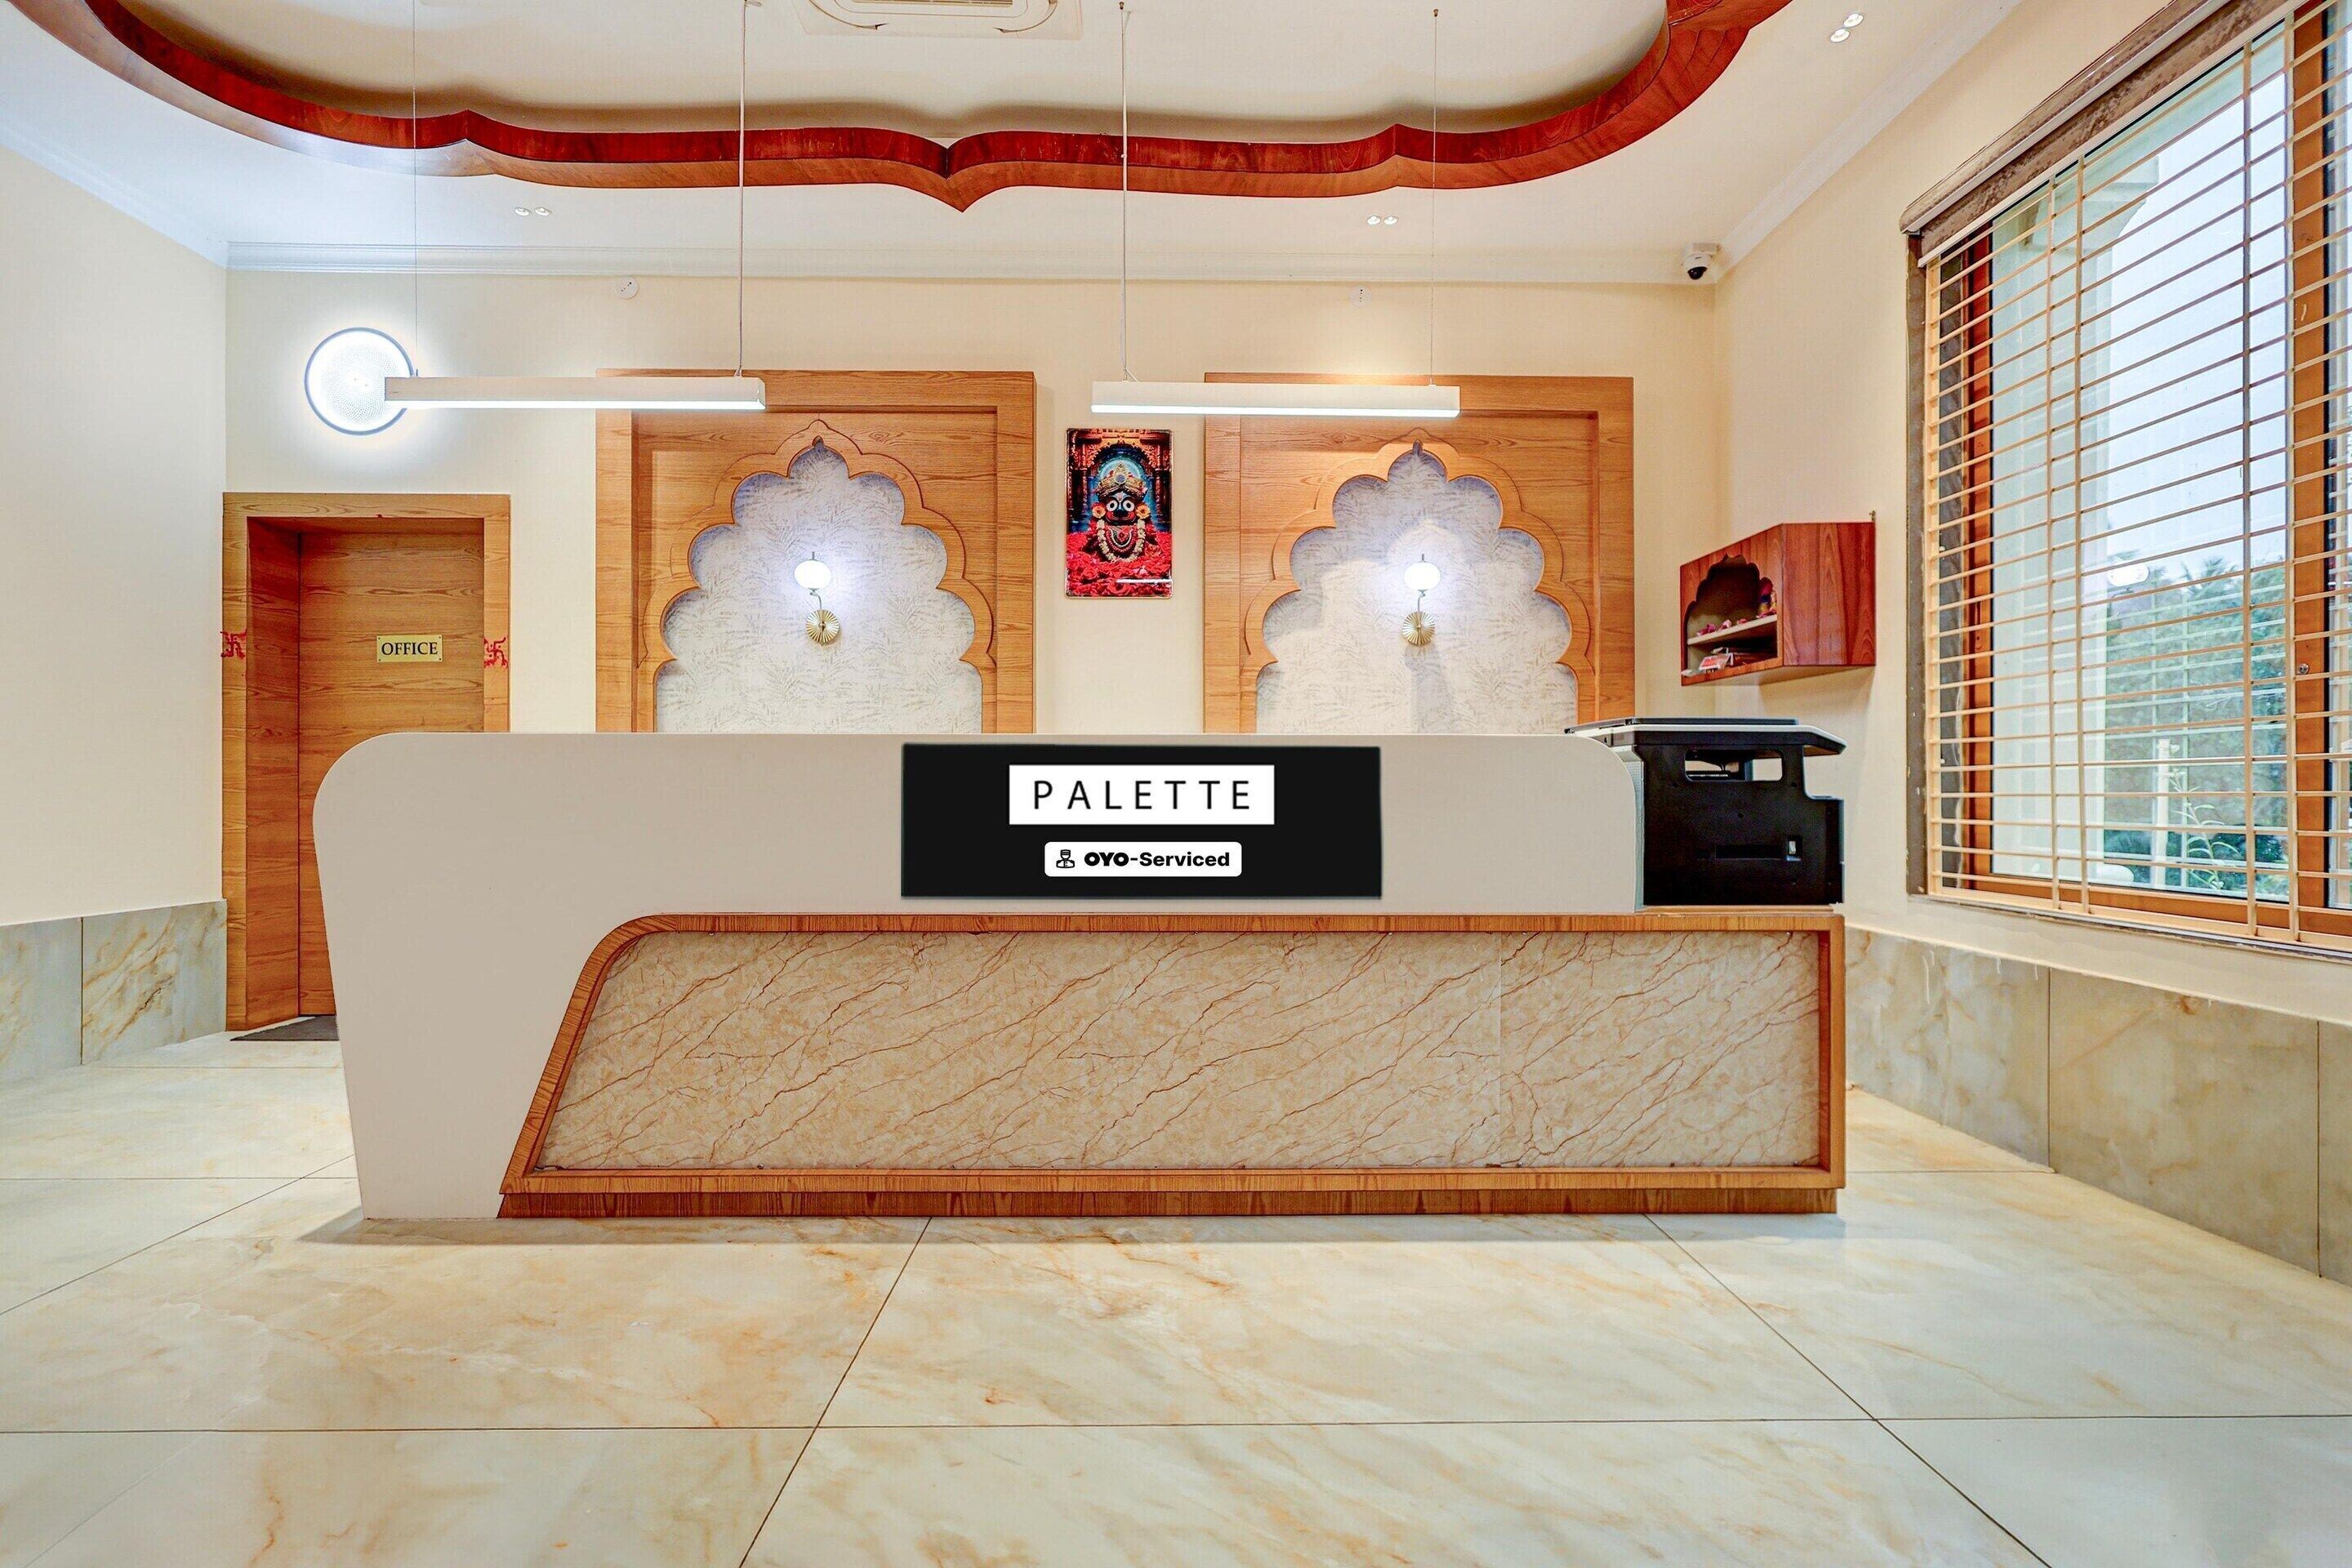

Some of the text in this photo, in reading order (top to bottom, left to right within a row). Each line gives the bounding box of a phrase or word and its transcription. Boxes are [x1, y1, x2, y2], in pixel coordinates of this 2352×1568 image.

[381, 641, 439, 656] OFFICE
[1033, 780, 1250, 810] PALETTE
[1084, 851, 1230, 867] OYO-Serviced
